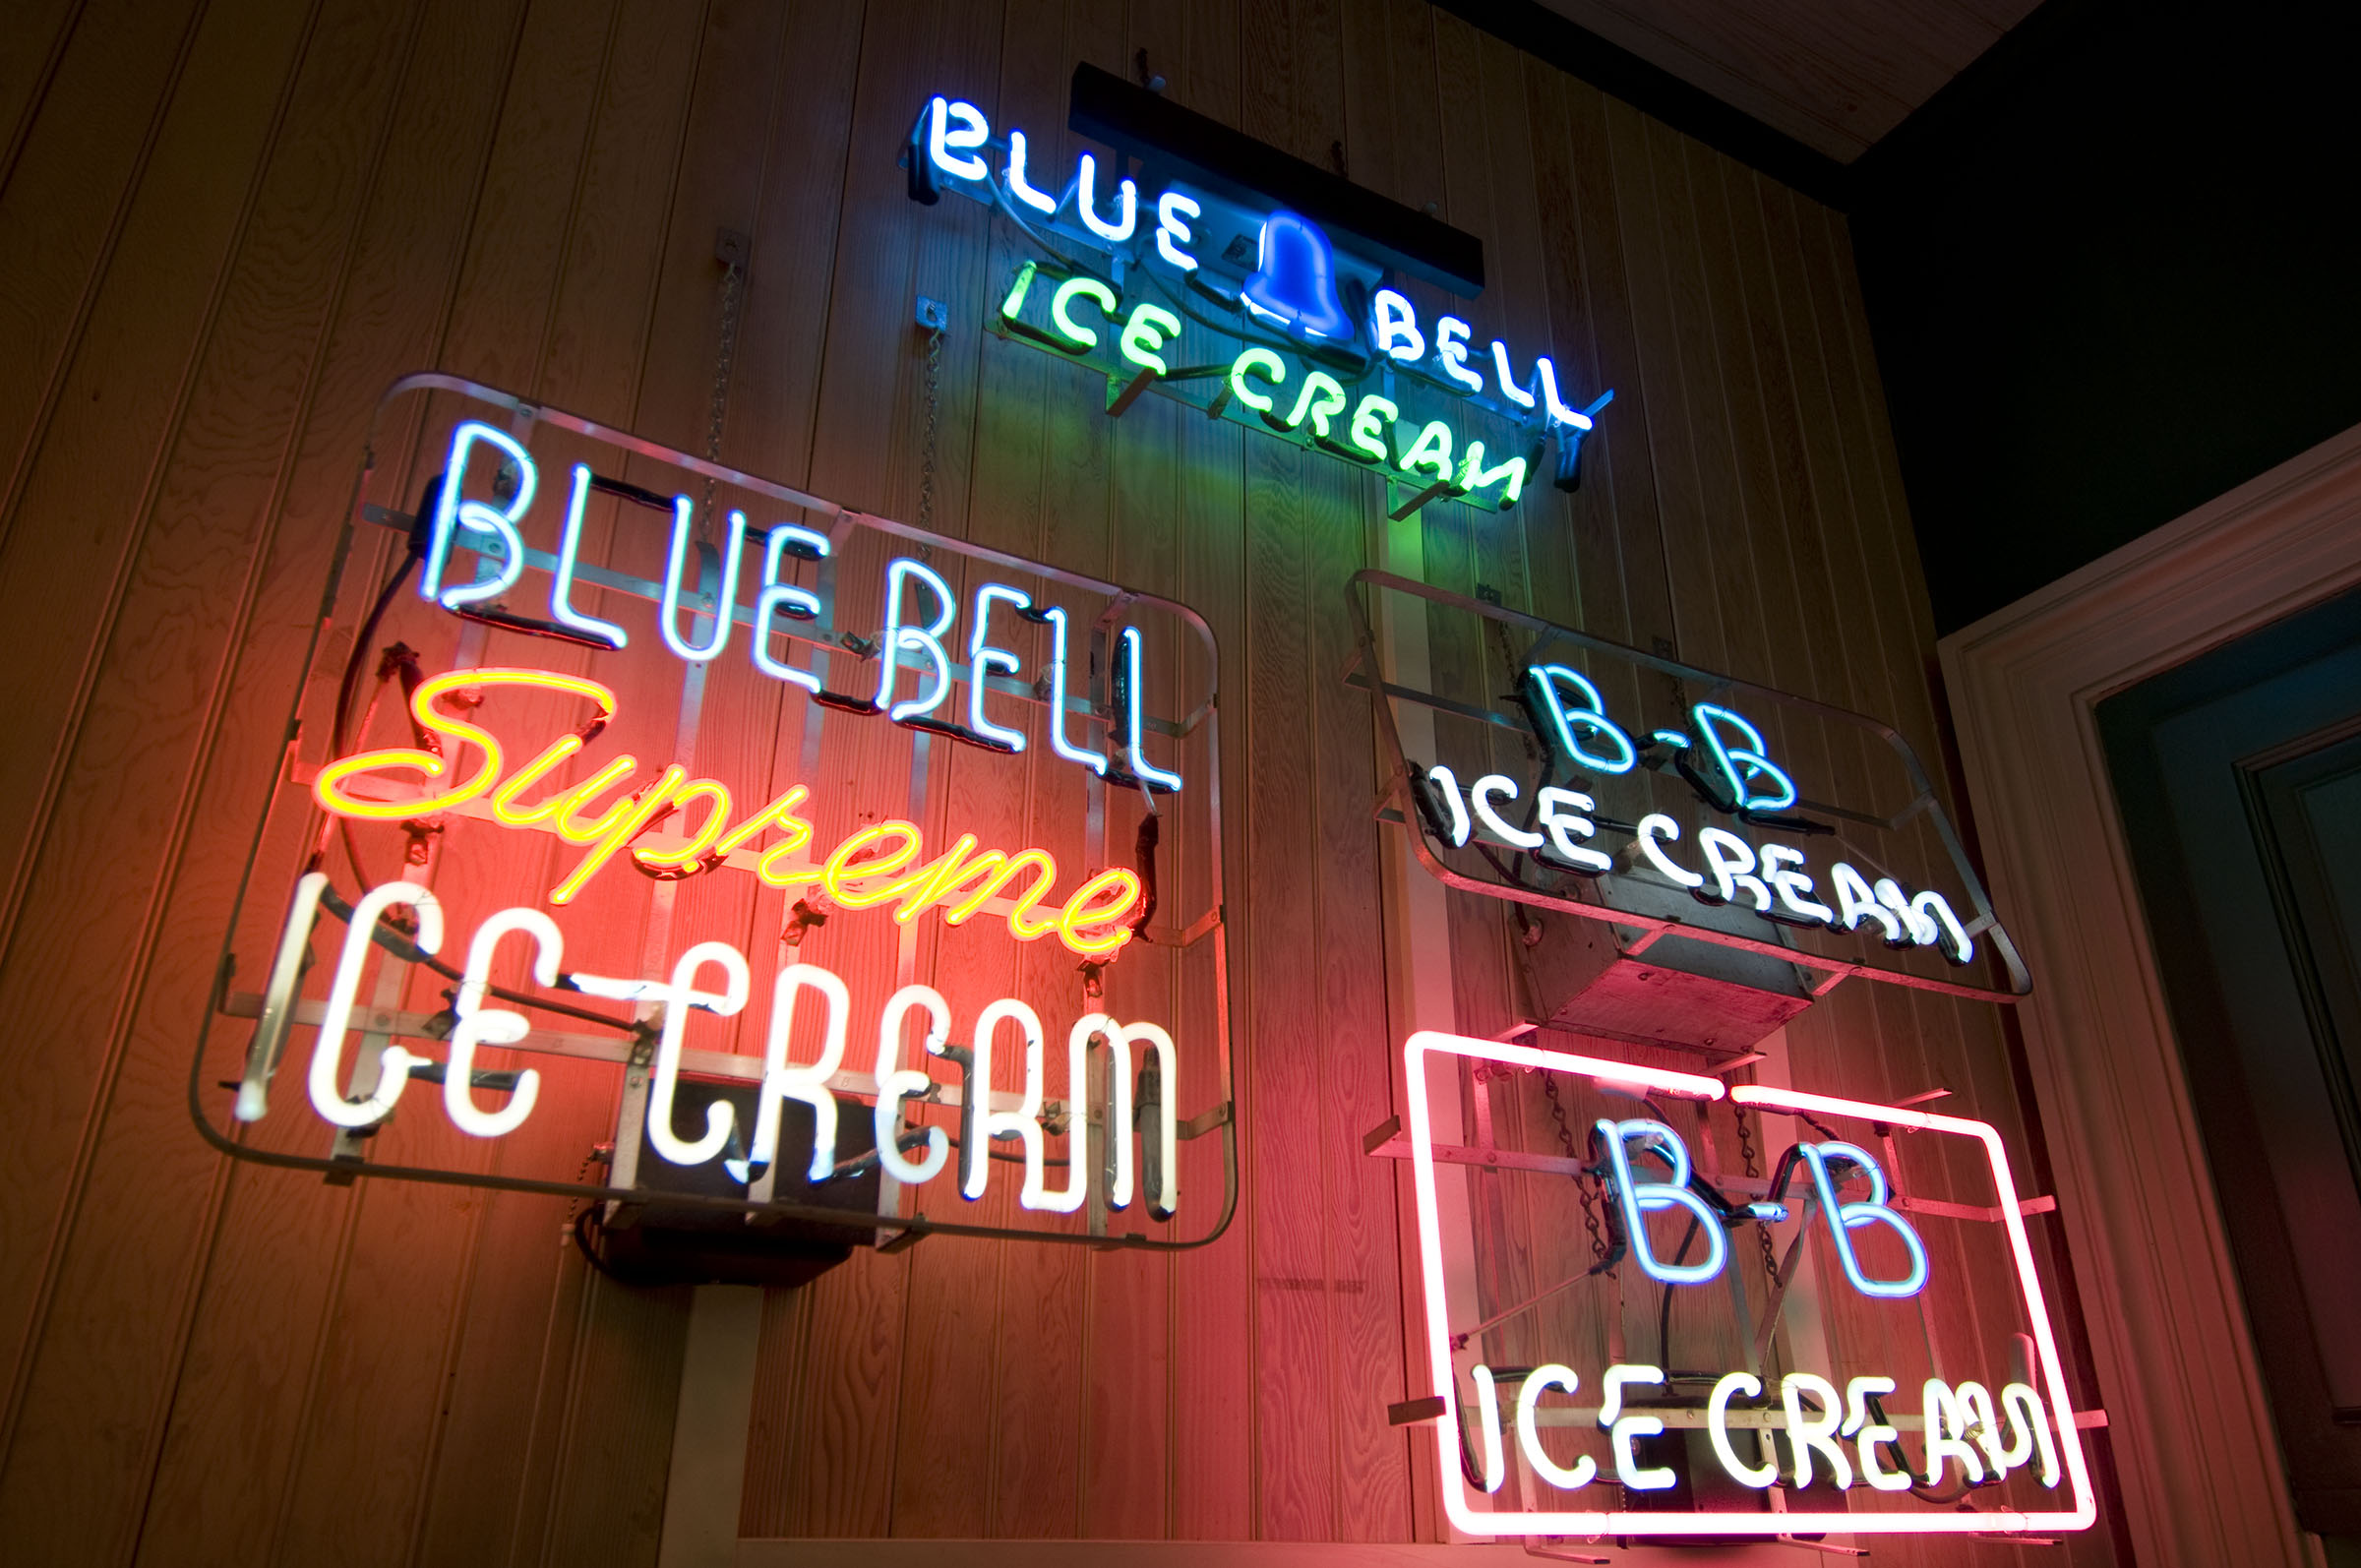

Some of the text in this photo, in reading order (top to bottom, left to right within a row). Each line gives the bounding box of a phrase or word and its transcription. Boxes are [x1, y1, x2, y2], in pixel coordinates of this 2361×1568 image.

[929, 95, 1593, 431] BLUE BELL
[1001, 261, 1528, 505] ICE CREAM
[423, 420, 1184, 793] BLUE BELL
[313, 669, 1143, 955] Supreme
[1427, 765, 1973, 965] ICE CREAM
[234, 872, 1178, 1221] ICE CREAM
[1471, 1363, 2060, 1493] ICE CREAM
